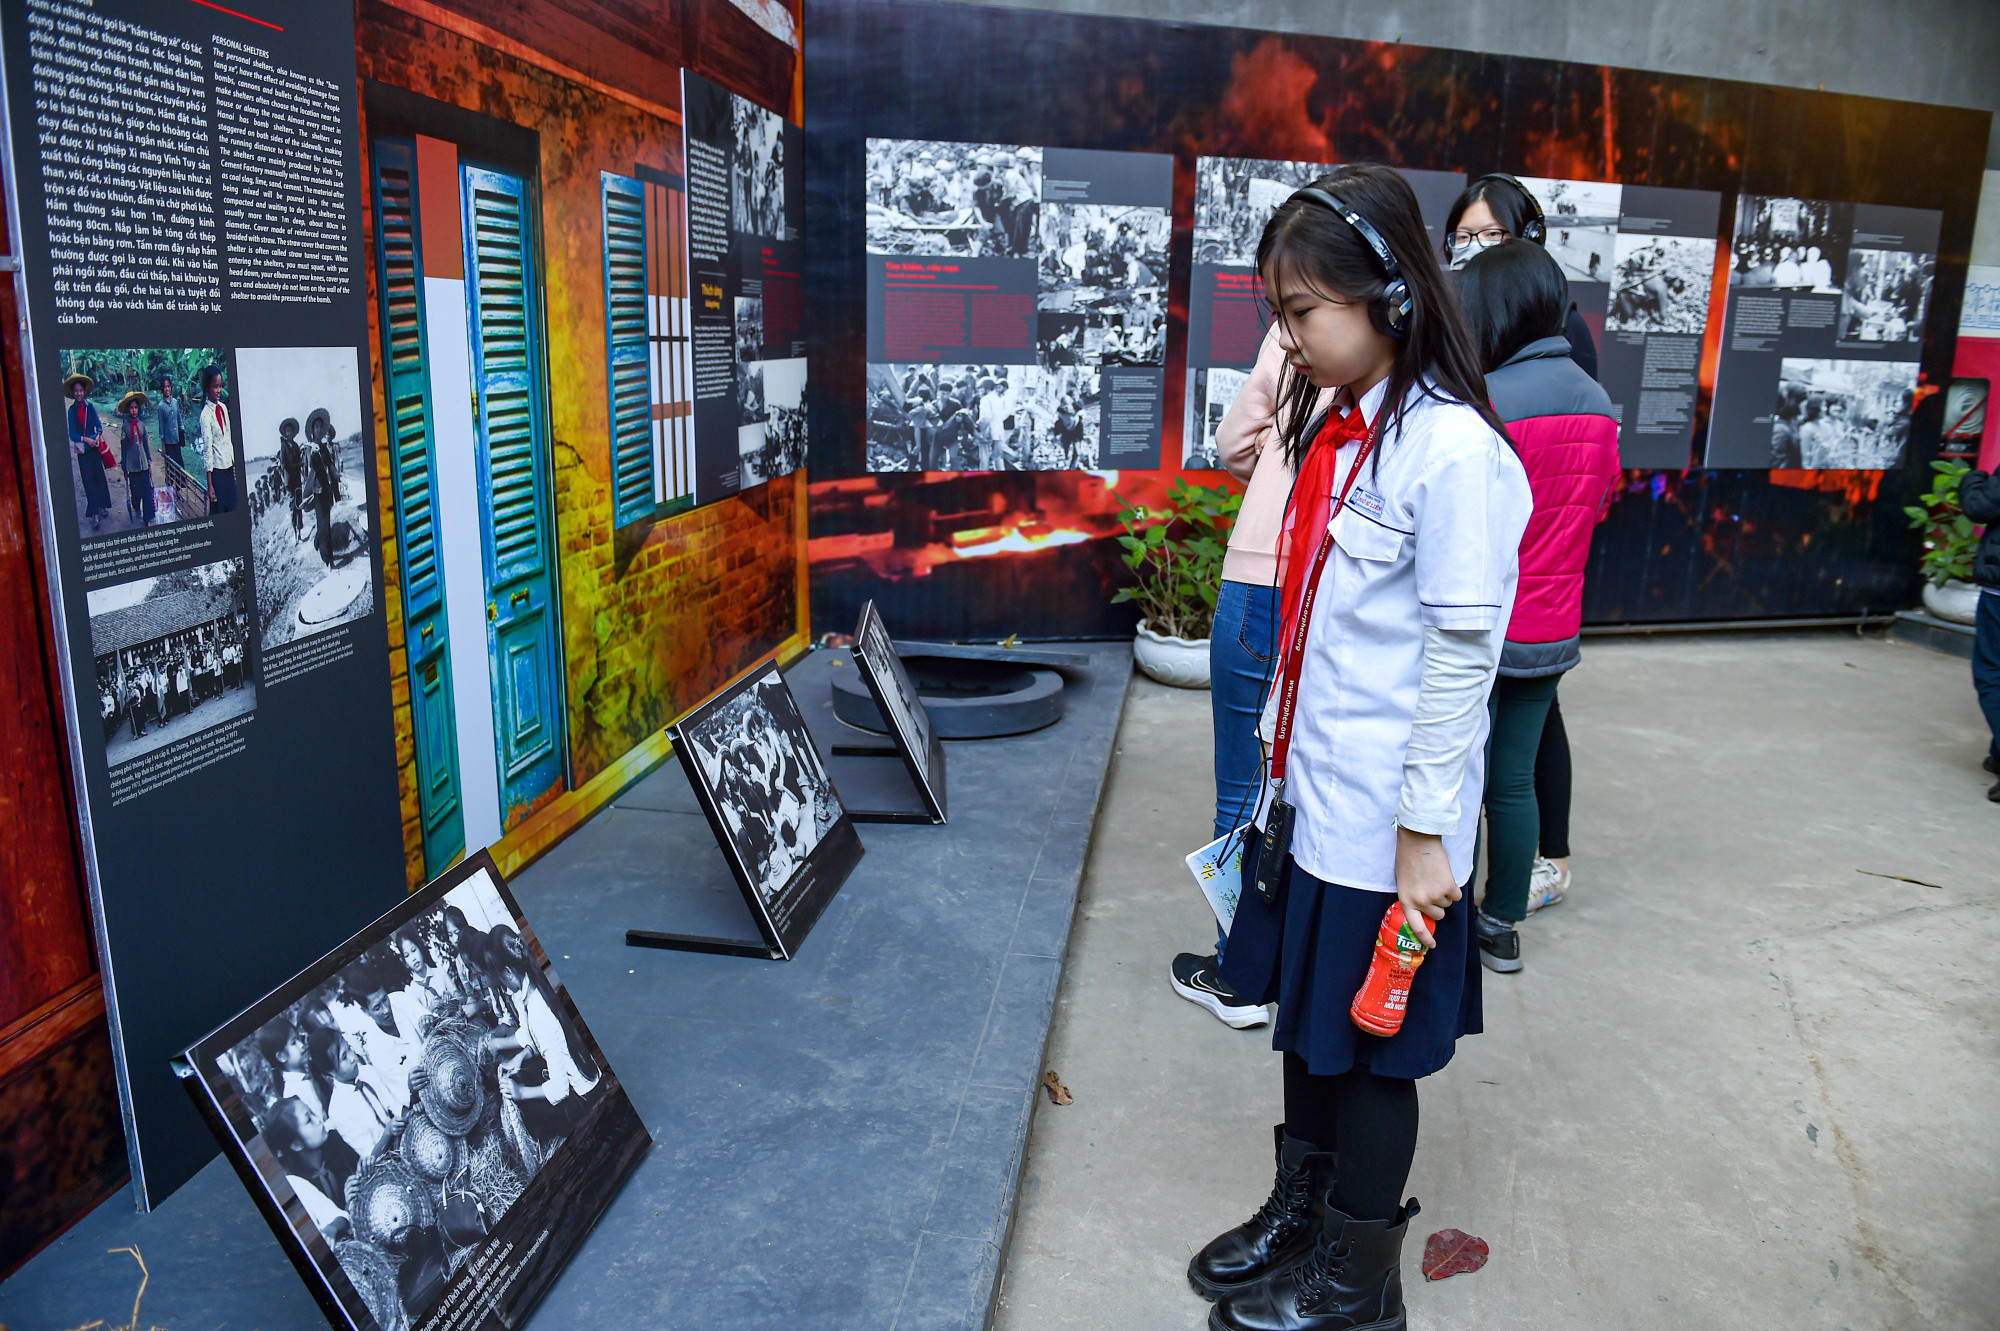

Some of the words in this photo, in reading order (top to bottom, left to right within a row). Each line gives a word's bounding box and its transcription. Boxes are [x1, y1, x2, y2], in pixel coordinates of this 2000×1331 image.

[49, 2, 61, 13] cá
[62, 5, 85, 20] nhân
[86, 12, 102, 25] còn
[103, 18, 117, 31] gọi
[118, 20, 127, 32] là
[180, 40, 190, 50] có
[190, 42, 202, 54] tác
[49, 247, 84, 263] thường
[87, 250, 109, 264] được
[111, 253, 125, 265] gọi
[127, 253, 135, 263] là
[138, 256, 152, 265] con
[154, 255, 170, 266] dúi.
[172, 257, 184, 267] Khi
[186, 258, 200, 268] vào
[202, 258, 218, 269] hầm
[52, 263, 72, 277] phải
[74, 264, 95, 278] ngồi
[96, 265, 117, 279] xổm,
[119, 267, 135, 278] đầu
[136, 269, 148, 279] cúi
[149, 269, 169, 283] thấp,
[170, 271, 182, 281] hai
[207, 275, 219, 285] tay
[53, 279, 69, 294] đặt
[72, 281, 91, 292] trên
[94, 281, 110, 292] đầu
[113, 282, 129, 296] gối,
[132, 284, 146, 294] che
[148, 284, 161, 295] hai
[163, 286, 174, 295] tai
[176, 286, 185, 296] và
[187, 287, 206, 299] tuyệt
[55, 296, 85, 310] không
[87, 297, 104, 310] dựa
[107, 298, 122, 308] vào
[125, 299, 144, 309] vách
[146, 298, 163, 309] hầm
[165, 299, 175, 310] để
[177, 301, 197, 310] tránh
[199, 301, 209, 313] áp
[210, 301, 221, 313] lực
[57, 312, 73, 323] của
[74, 312, 98, 323] bom.
[1295, 589, 1314, 652] www.orpheo.org
[1278, 679, 1295, 740] www.orpheo.org
[1397, 935, 1422, 951] fuze
[498, 1247, 510, 1262] bom
